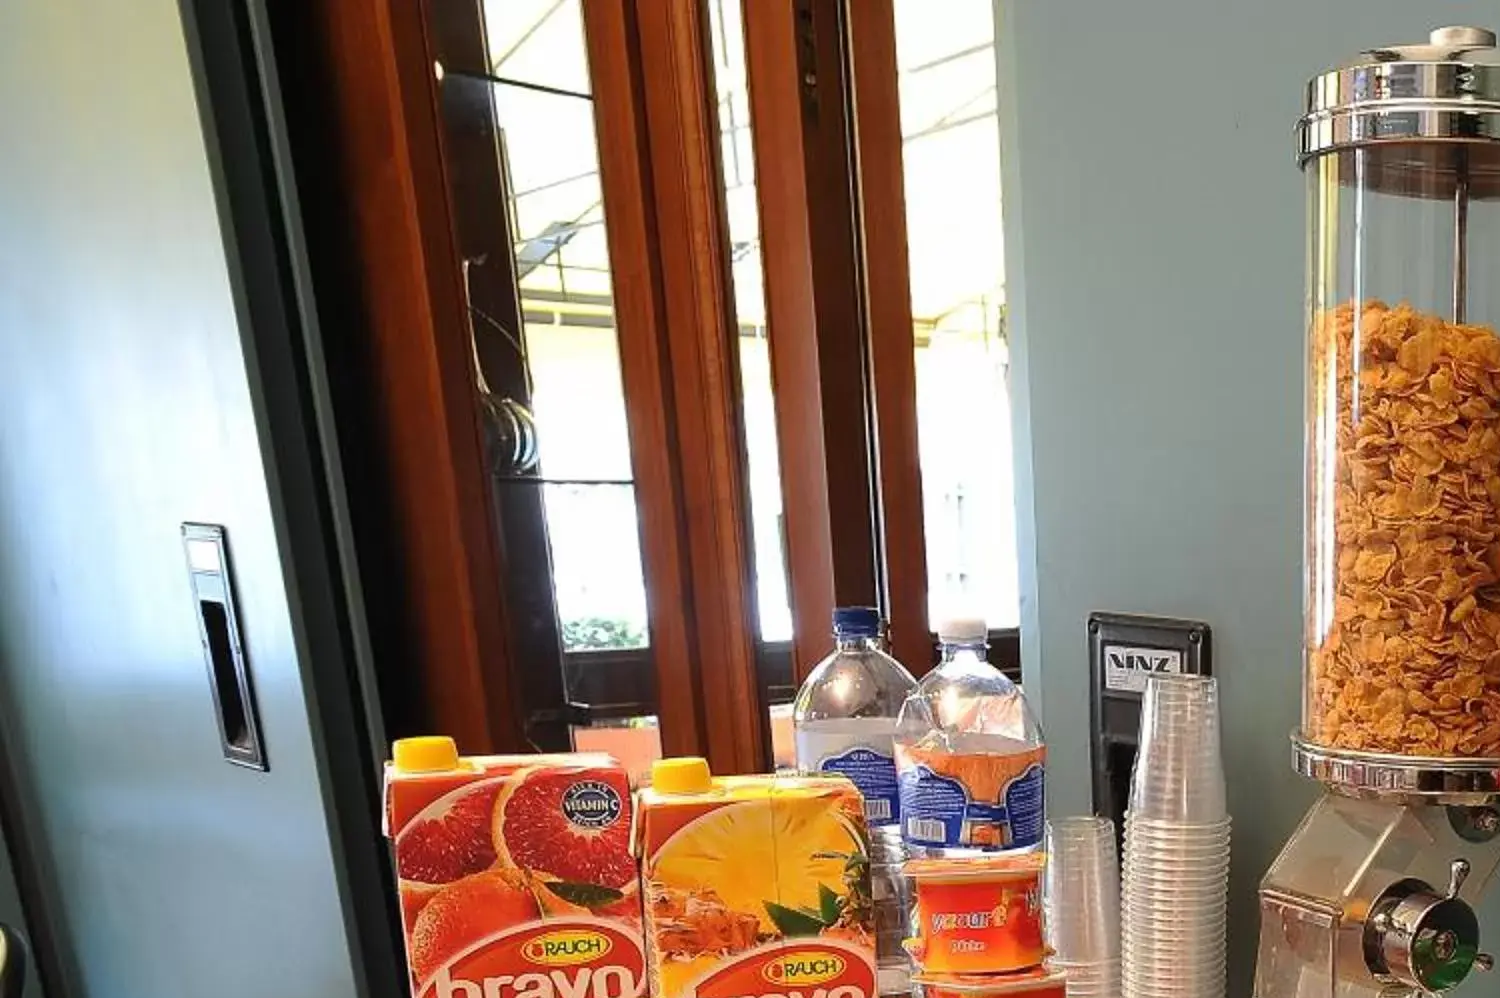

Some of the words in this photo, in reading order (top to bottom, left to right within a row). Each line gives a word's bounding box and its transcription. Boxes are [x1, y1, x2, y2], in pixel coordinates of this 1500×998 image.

[565, 799, 608, 812] VITAMIN
[610, 799, 619, 811] C
[544, 938, 601, 957] RAUCH
[785, 958, 837, 977] RAUCH
